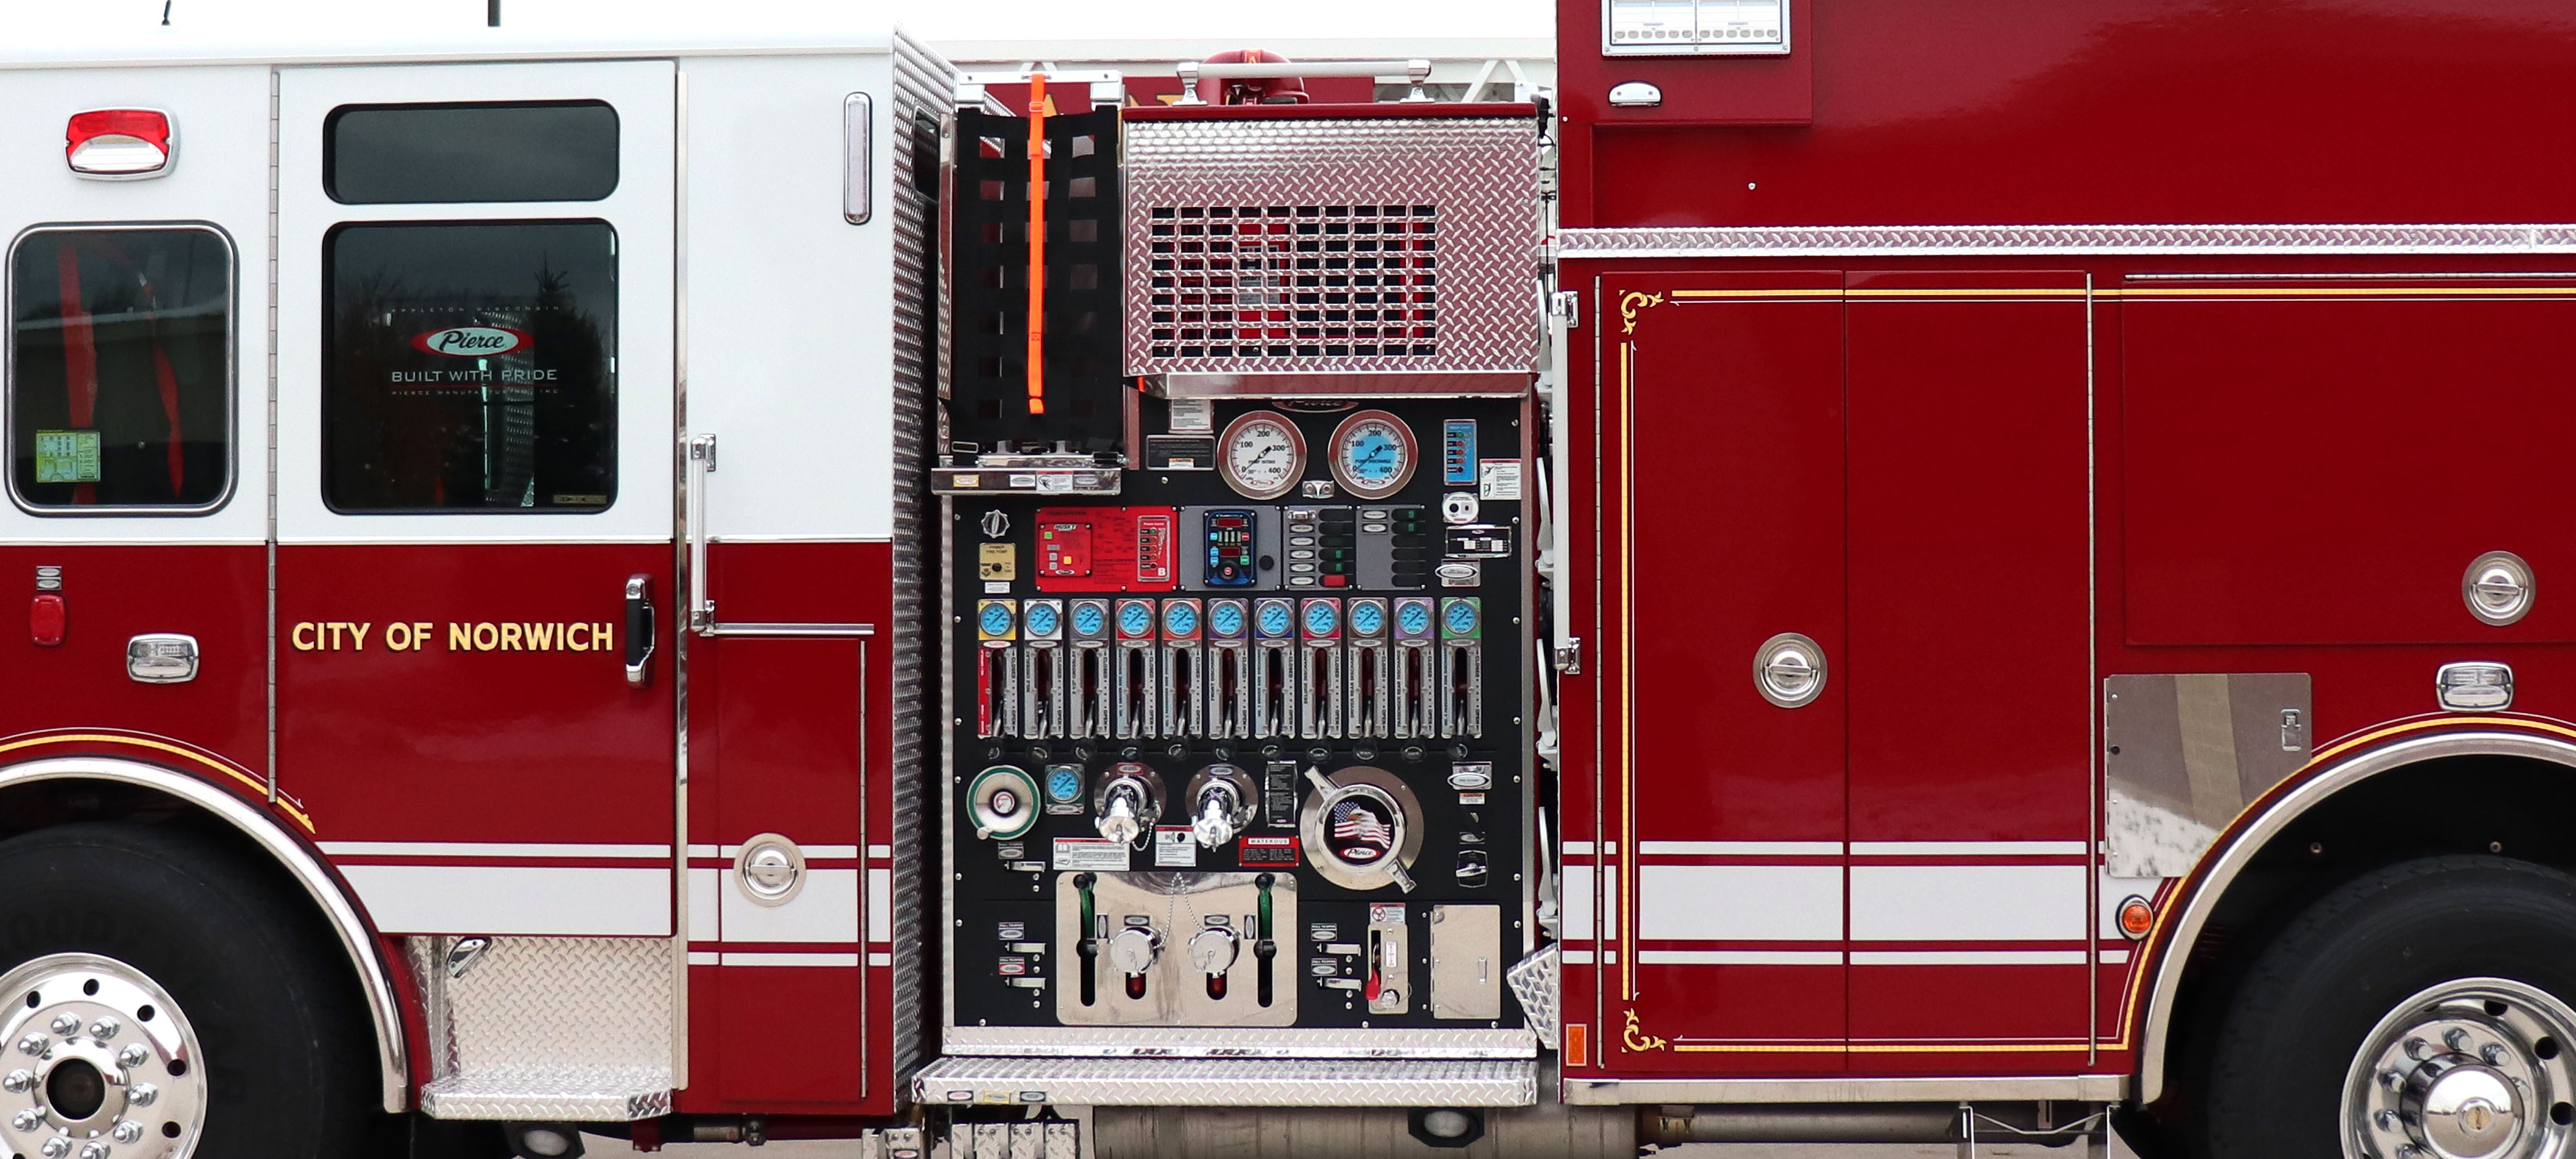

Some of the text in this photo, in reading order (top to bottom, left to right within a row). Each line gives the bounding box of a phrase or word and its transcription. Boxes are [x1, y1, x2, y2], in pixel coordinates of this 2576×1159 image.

[438, 330, 505, 351] Pierce
[391, 369, 558, 383] BUILT WITH PRIDE
[1158, 567, 1166, 576] B
[291, 622, 614, 653] CITY OF NORWICH
